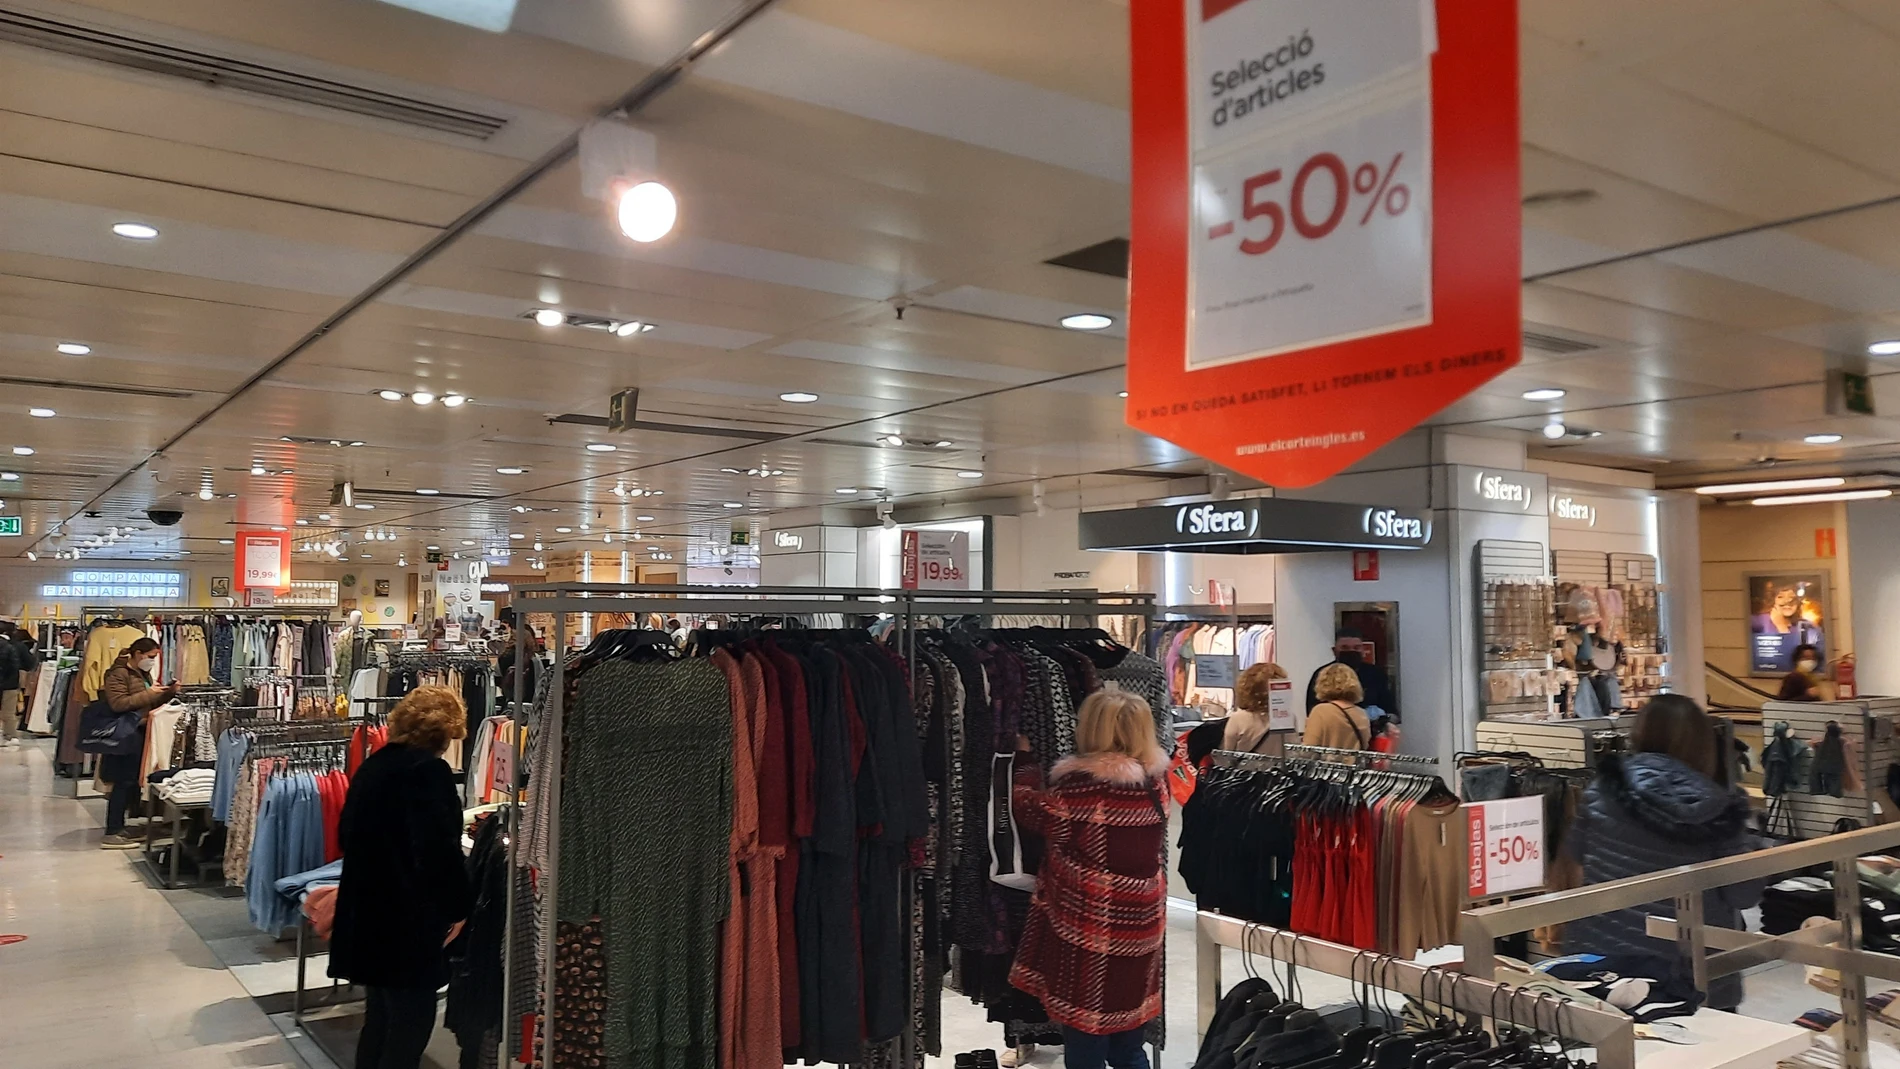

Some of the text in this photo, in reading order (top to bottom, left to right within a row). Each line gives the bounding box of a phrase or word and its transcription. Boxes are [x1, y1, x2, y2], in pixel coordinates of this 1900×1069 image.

[1211, 28, 1314, 97] Selecció
[1212, 63, 1326, 127] d'articles
[1208, 151, 1411, 256] -50%
[1192, 394, 1237, 412] QUEDA
[1332, 367, 1397, 389] TORNEM
[1403, 361, 1434, 378] ELS
[1440, 348, 1506, 372] DINERS
[1235, 429, 1366, 456] www.elcorteingles.es
[1470, 818, 1484, 889] rebajas
[1489, 835, 1539, 865] -50%
